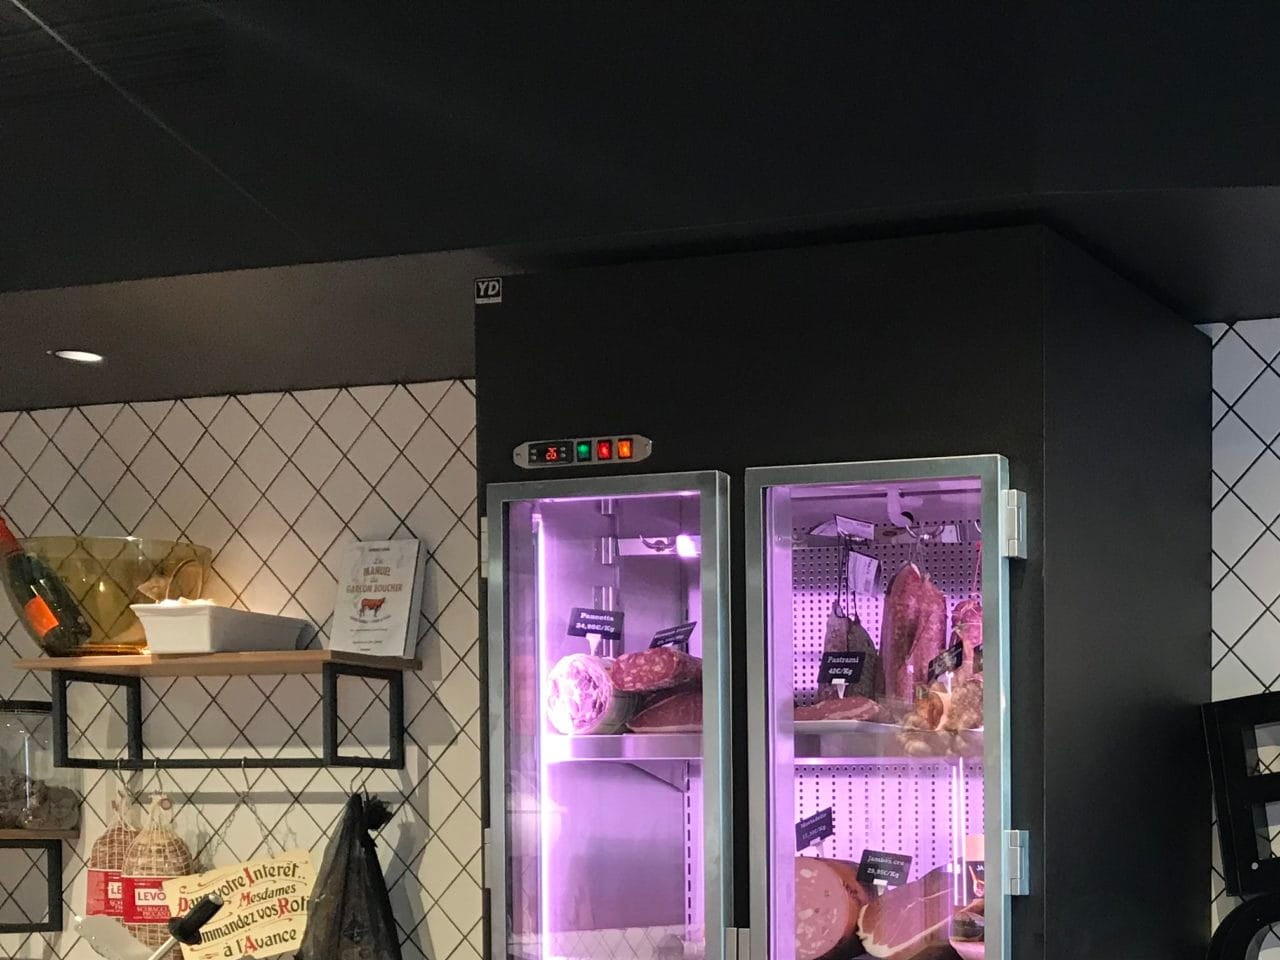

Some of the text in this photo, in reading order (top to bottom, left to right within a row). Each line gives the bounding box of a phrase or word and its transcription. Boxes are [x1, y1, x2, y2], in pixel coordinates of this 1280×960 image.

[478, 281, 499, 296] YD
[363, 566, 391, 576] MANUEL
[827, 655, 859, 663] Pastrami
[238, 883, 297, 908] Mesdames
[257, 903, 279, 920] vos
